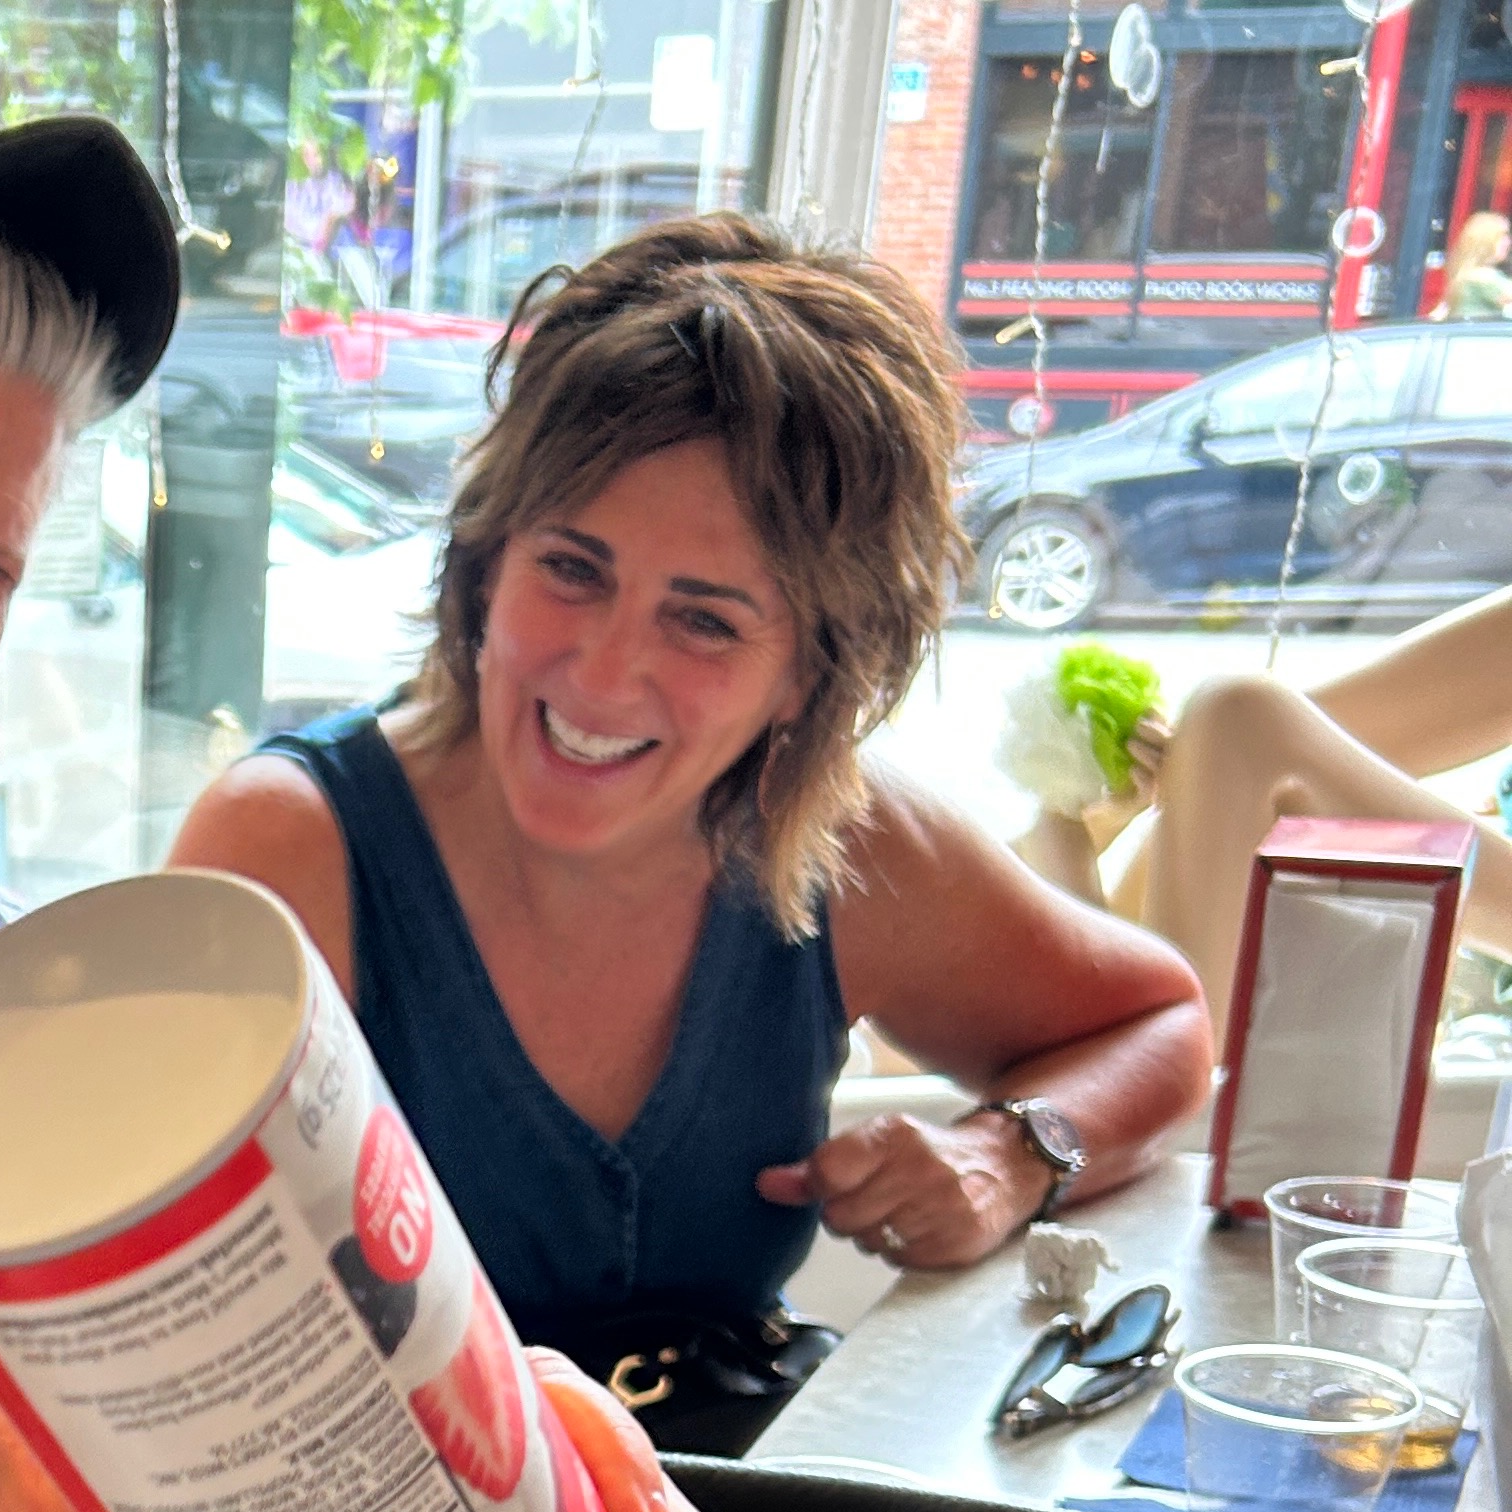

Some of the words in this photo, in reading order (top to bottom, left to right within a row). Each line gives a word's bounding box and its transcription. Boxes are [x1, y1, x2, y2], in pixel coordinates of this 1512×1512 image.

[1205, 280, 1257, 300] BOOK
[389, 1166, 425, 1266] NO
[169, 1308, 209, 1333] love
[107, 1336, 150, 1354] hear
[180, 1379, 252, 1417] difference
